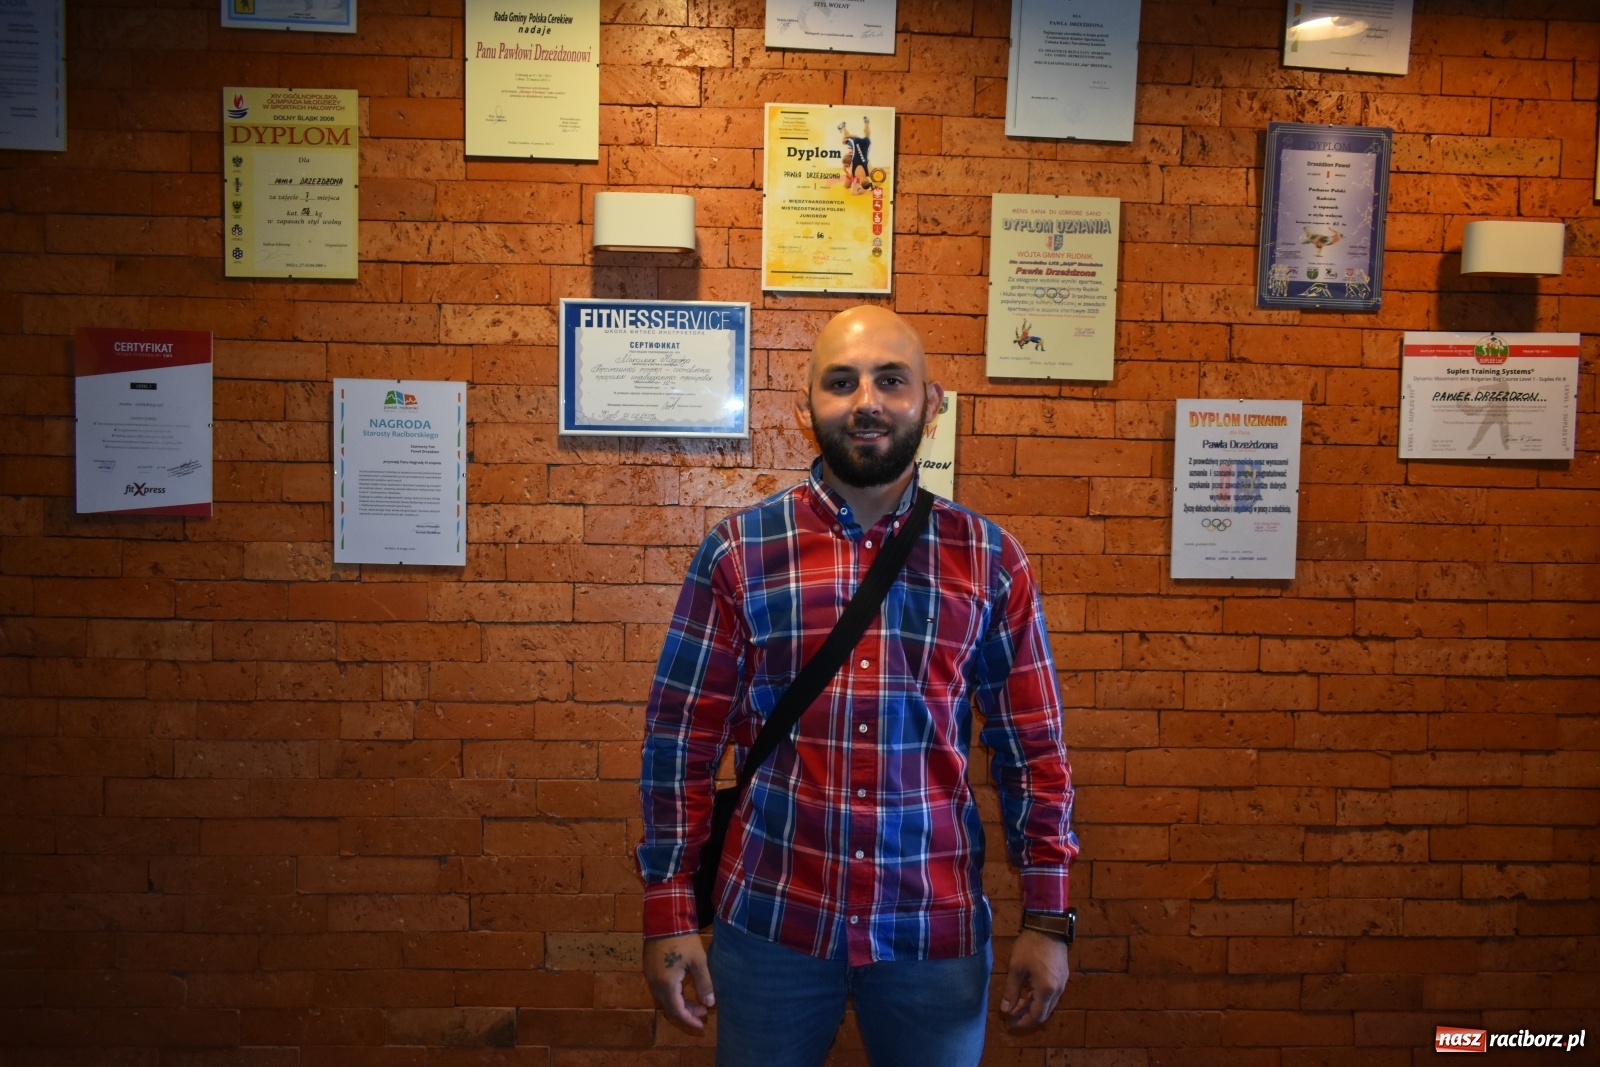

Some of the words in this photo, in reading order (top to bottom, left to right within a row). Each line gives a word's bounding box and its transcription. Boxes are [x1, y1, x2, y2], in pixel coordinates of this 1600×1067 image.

[493, 11, 508, 22] Rada
[508, 12, 527, 25] Gminy
[528, 13, 547, 23] Polska
[547, 14, 573, 24] Cerekiew
[476, 42, 497, 59] Panu
[498, 43, 533, 60] Pawłowi
[282, 92, 337, 100] OGÓLNOPOLSKA
[230, 125, 351, 146] DYPLOM
[1308, 141, 1351, 151] DYPLOM
[787, 146, 842, 161] Dyplom
[315, 210, 323, 218] kg
[322, 219, 342, 227] wolny
[1002, 218, 1054, 234] DYPLOM
[1056, 219, 1112, 235] UZNANIA
[1066, 252, 1093, 260] RUDNIK
[1015, 267, 1043, 276] Pawła
[580, 308, 731, 330] FITNESSERVICE
[114, 342, 174, 353] CERTYFIKAT
[629, 341, 680, 350] СЕРТИФИКАТ
[1447, 368, 1469, 377] Suples
[1472, 368, 1500, 377] Training
[1432, 391, 1472, 401] PAWEŁ
[370, 419, 432, 430] NAGRODA
[1189, 411, 1241, 428] DYPLOM
[1244, 414, 1289, 428] UZNANIA
[363, 430, 391, 439] Starosty
[392, 431, 439, 441] Raciborskiego
[1203, 439, 1228, 449] Pawła
[1230, 440, 1278, 450] Drzeżdzona
[1193, 458, 1218, 466] prawdziwą
[1220, 458, 1254, 467] przyjemnością
[1266, 459, 1289, 467] wyrazami
[124, 482, 166, 496] fitXpress
[1189, 482, 1210, 490] uzyskania
[1270, 483, 1287, 491] dobrych
